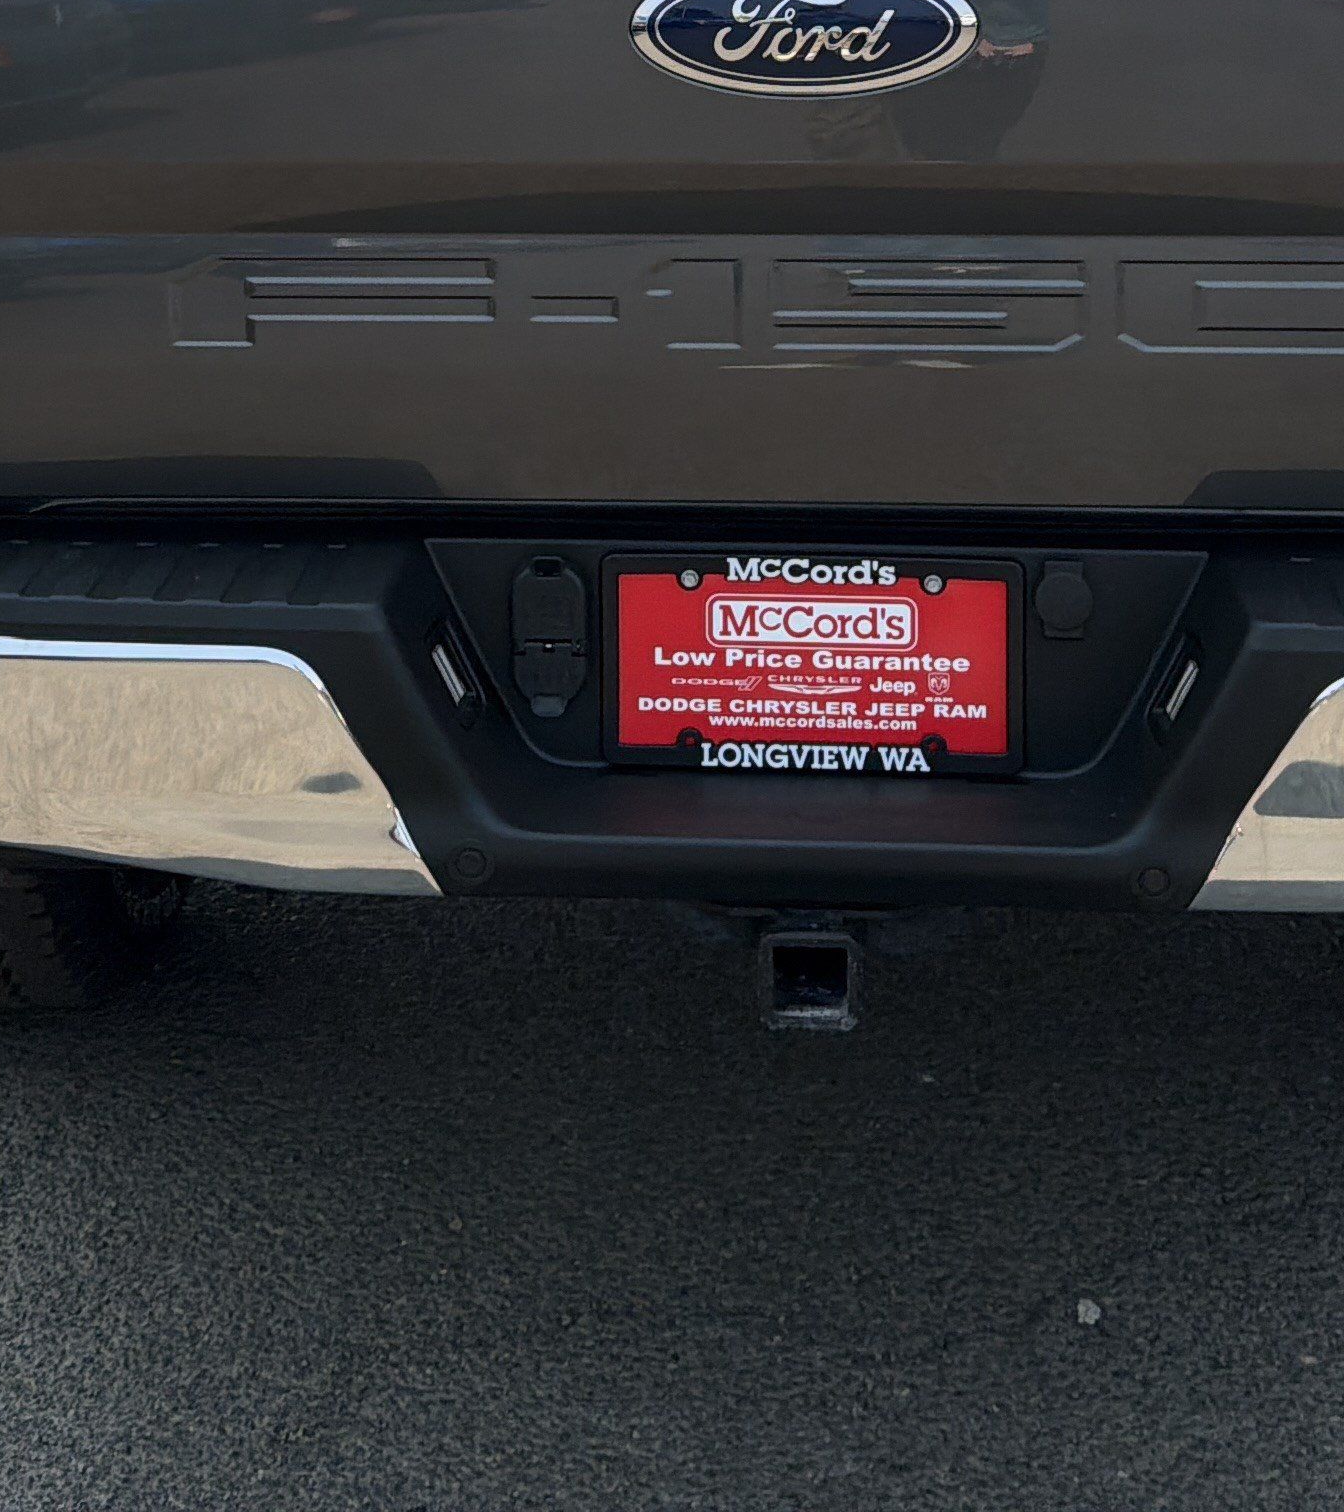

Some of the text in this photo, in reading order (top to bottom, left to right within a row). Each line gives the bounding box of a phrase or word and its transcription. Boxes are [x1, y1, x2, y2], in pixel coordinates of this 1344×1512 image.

[726, 557, 896, 586] McCord's
[718, 603, 905, 641] McCord's
[654, 646, 971, 673] Low Price Guarantee
[671, 677, 748, 686] DODGE
[767, 674, 863, 685] CHRYSLER
[869, 676, 916, 696] Jeep
[638, 696, 988, 719] DODGE CHRYSLER JEEP RAM
[708, 713, 918, 731] www.mccordsales.com
[701, 741, 931, 774] LONGVIEW WA
